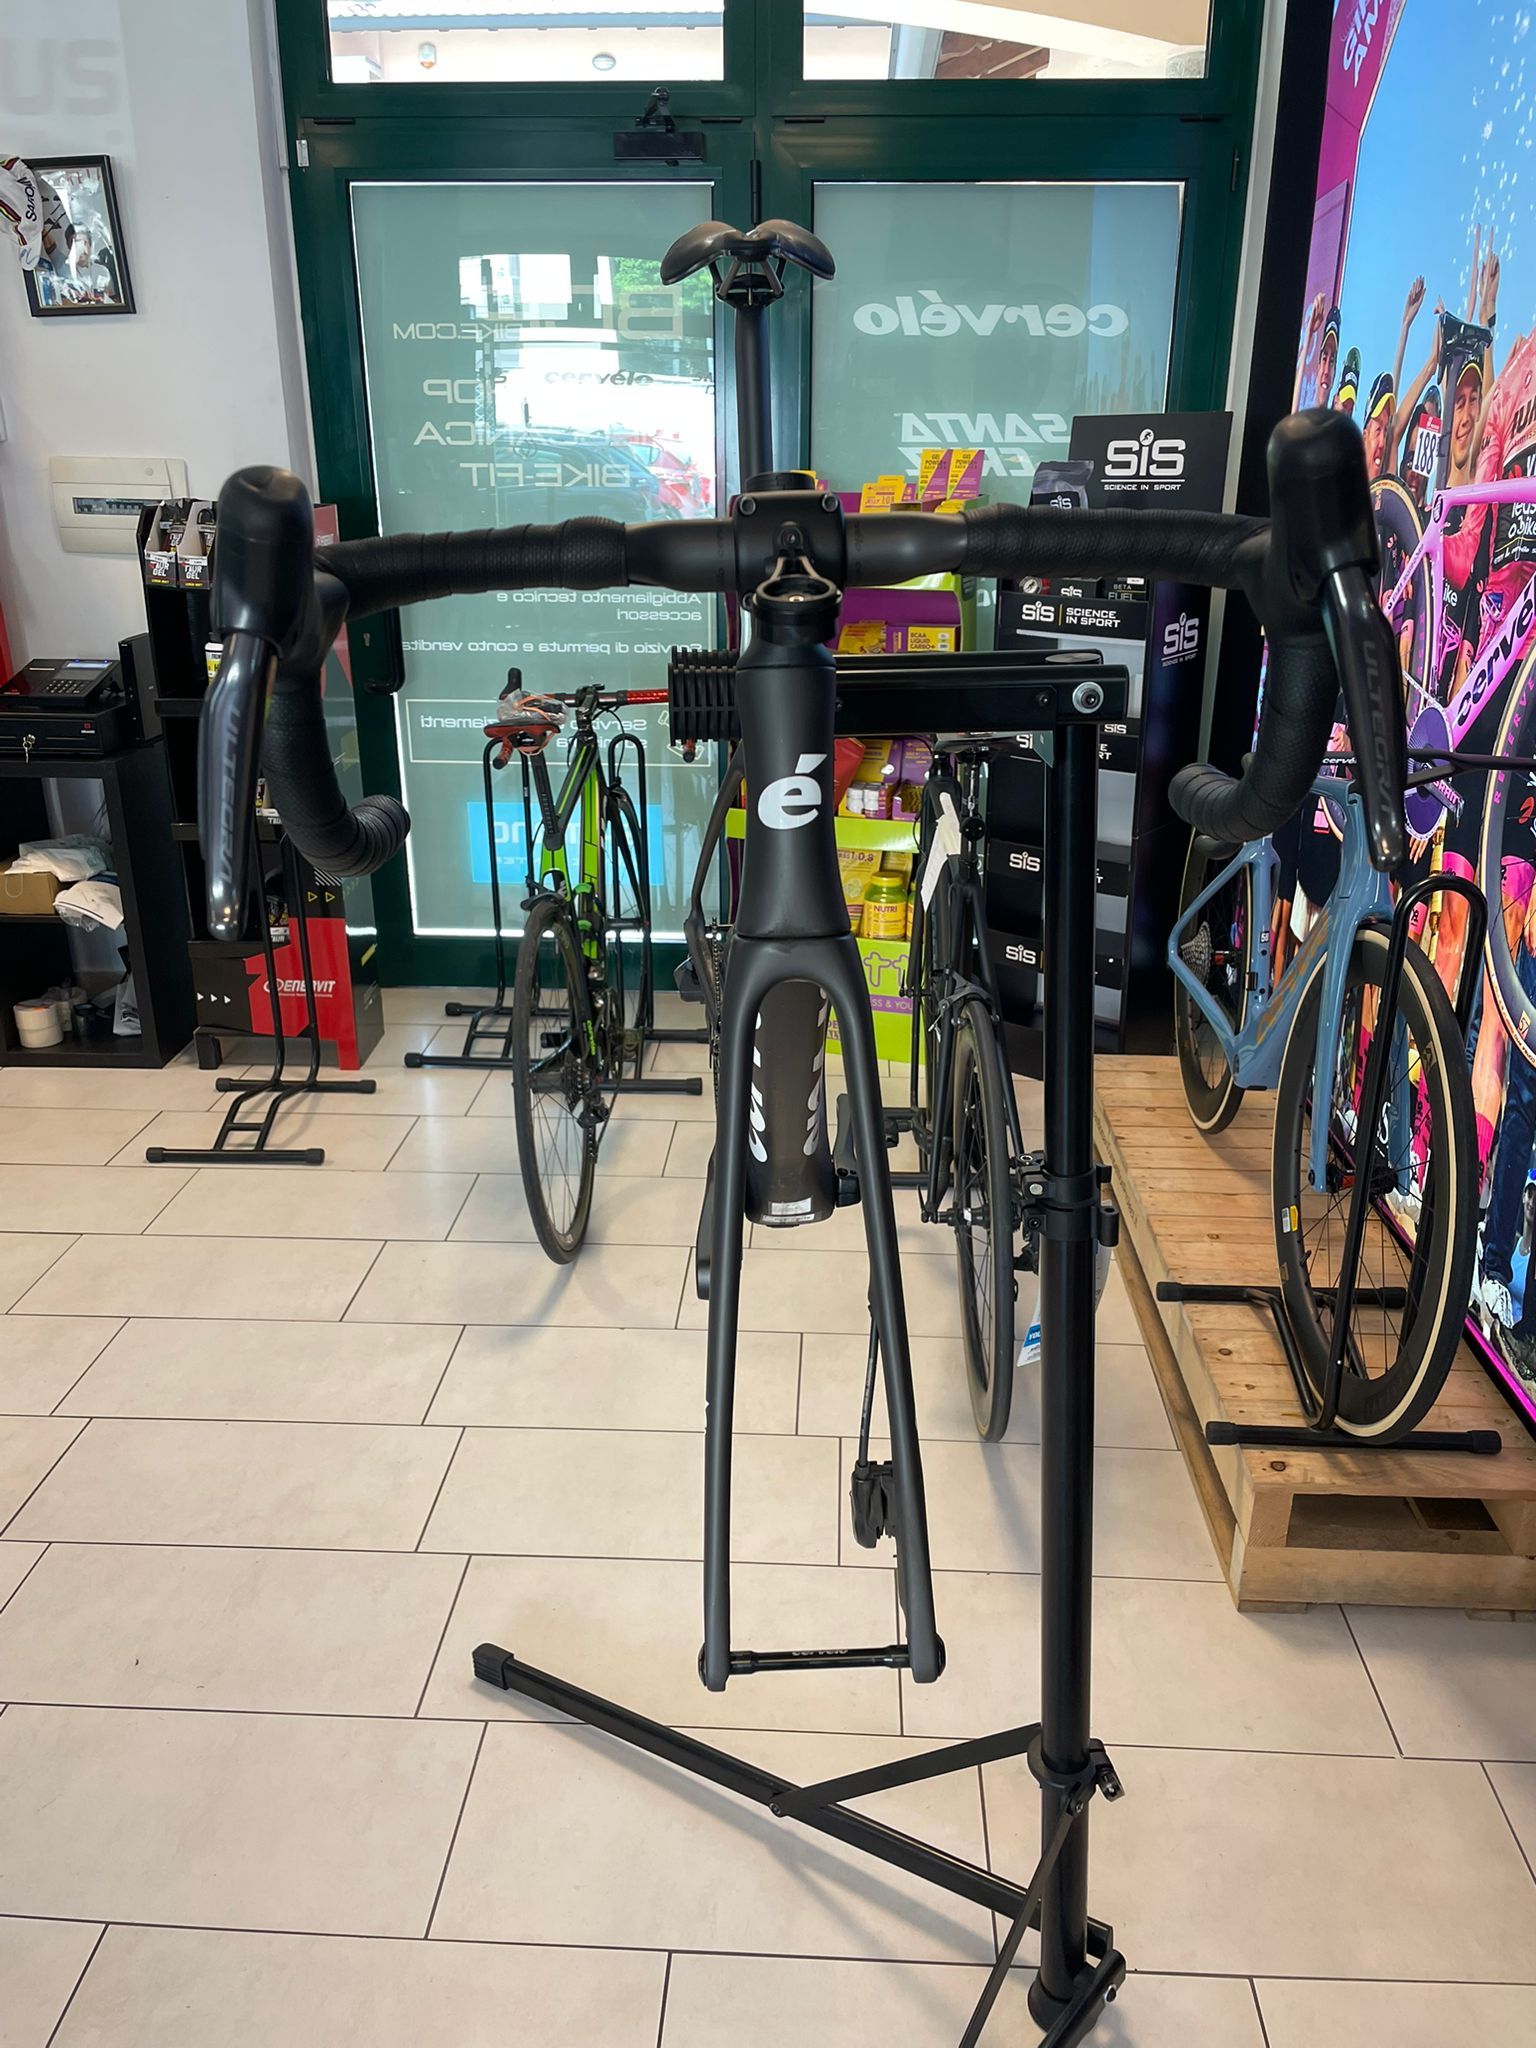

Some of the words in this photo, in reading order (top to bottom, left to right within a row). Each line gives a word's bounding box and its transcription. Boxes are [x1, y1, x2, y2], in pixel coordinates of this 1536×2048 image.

[1154, 483, 1181, 491] SPORT
[1442, 582, 1458, 607] ike
[1066, 607, 1117, 619] SCIENCE
[1065, 615, 1077, 624] IN
[1080, 617, 1121, 628] SPORT
[1456, 579, 1536, 727] cervé
[873, 904, 898, 913] NUTRI
